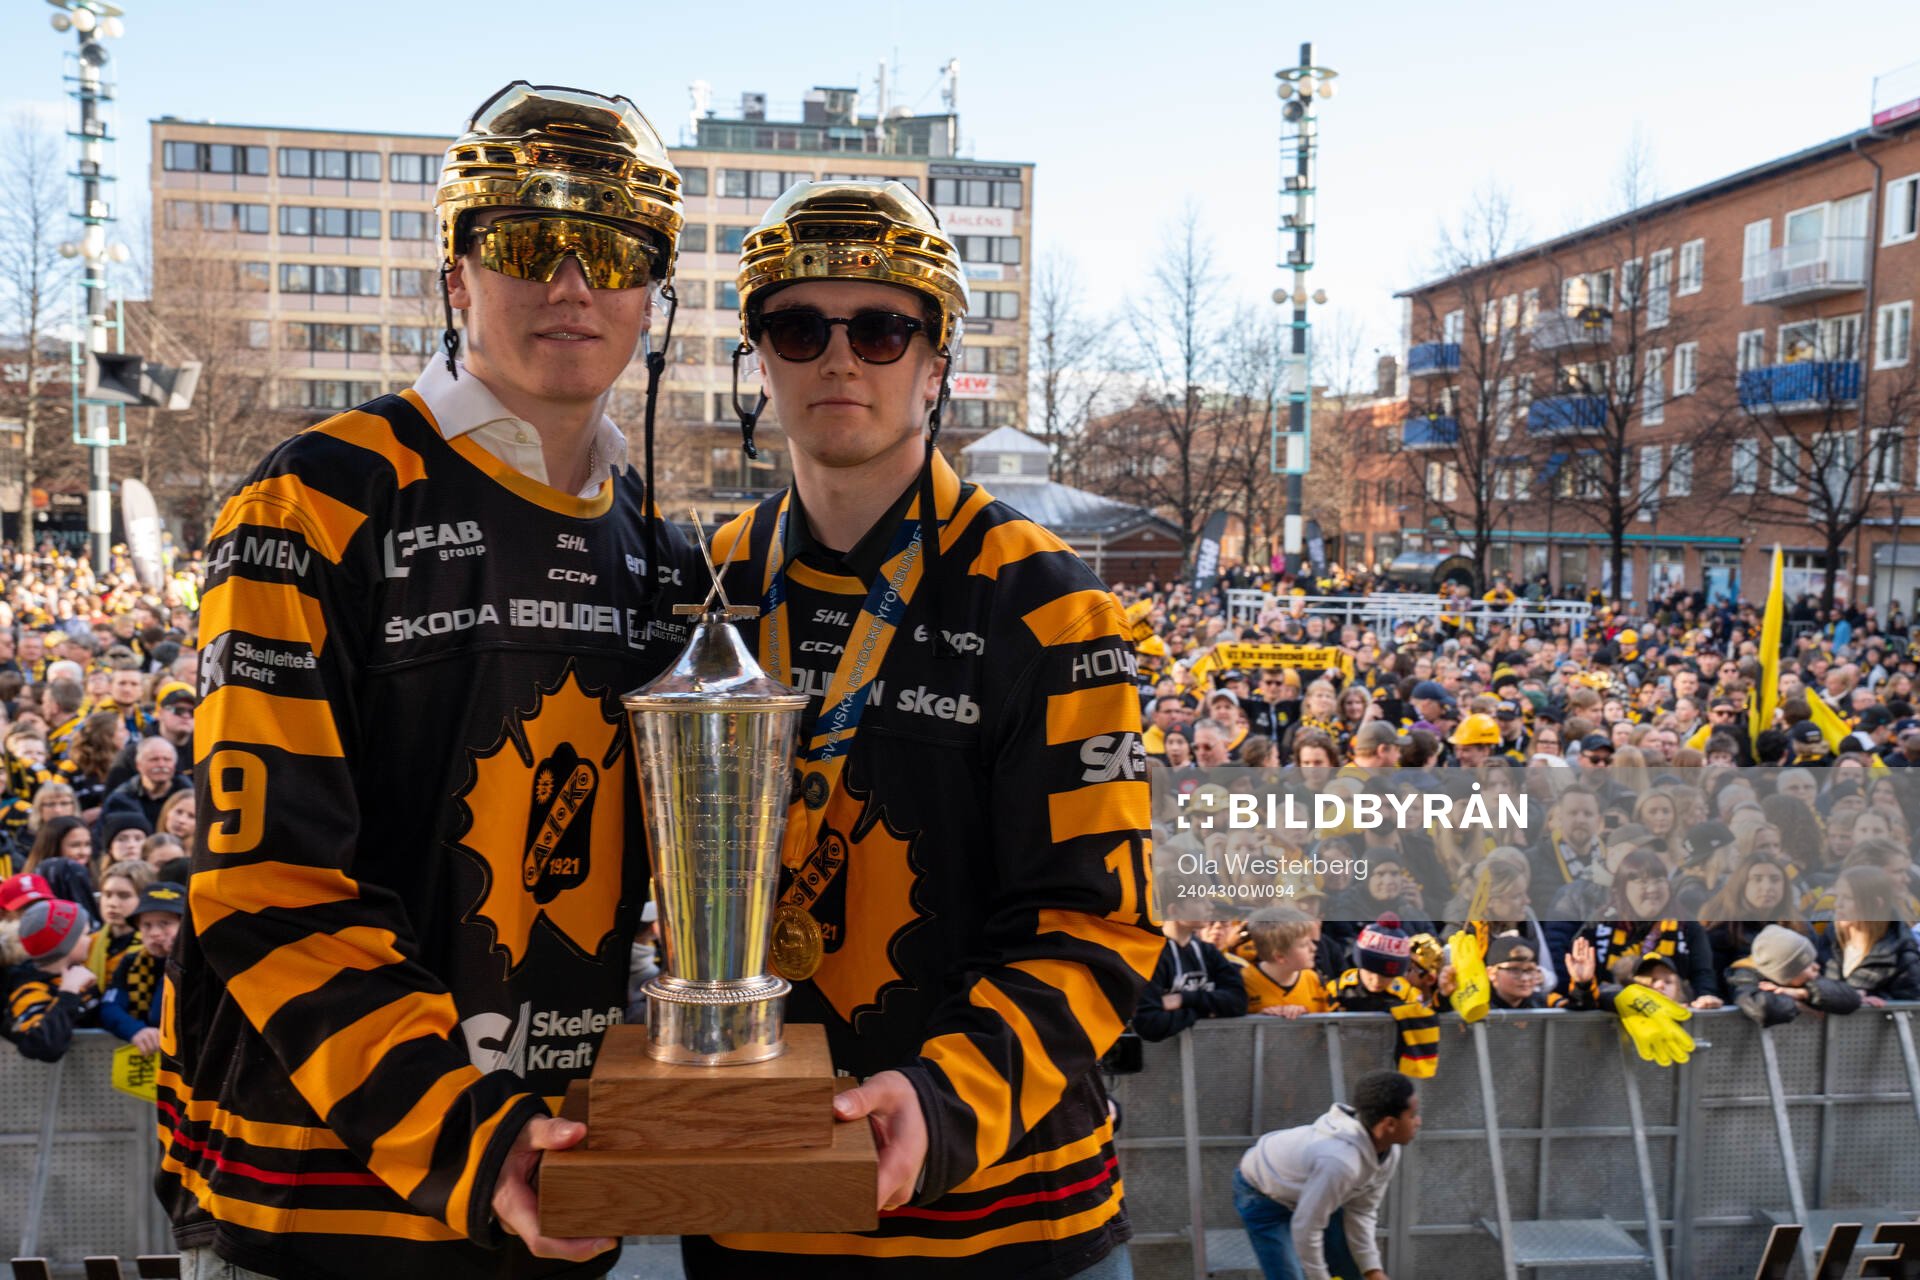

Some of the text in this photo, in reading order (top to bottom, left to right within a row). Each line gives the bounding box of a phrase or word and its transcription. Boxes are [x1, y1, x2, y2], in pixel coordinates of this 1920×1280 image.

[947, 211, 1004, 227] ÅHLENS
[439, 544, 486, 561] group
[556, 533, 589, 553] SHL
[548, 568, 598, 585] CCM
[384, 604, 500, 643] ŠKODA
[812, 609, 850, 627] SHL
[233, 641, 317, 669] Skellefteå
[231, 660, 276, 685] Kraft
[820, 691, 856, 763] SVENSKA
[208, 749, 268, 854] 9
[531, 1006, 625, 1038] Skelleft
[527, 1042, 593, 1071] Kraft
